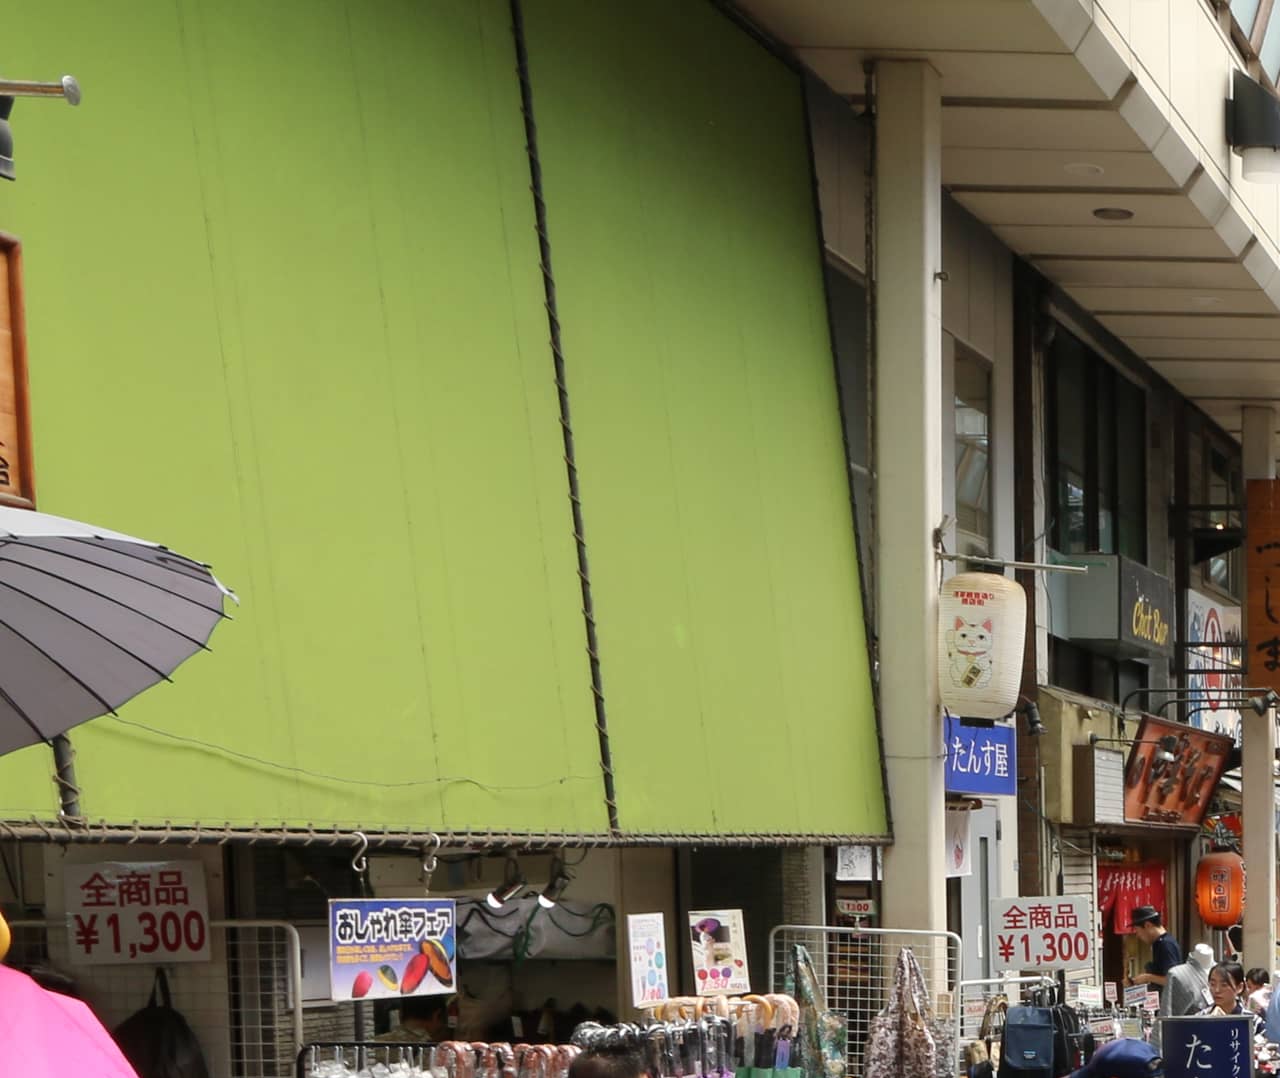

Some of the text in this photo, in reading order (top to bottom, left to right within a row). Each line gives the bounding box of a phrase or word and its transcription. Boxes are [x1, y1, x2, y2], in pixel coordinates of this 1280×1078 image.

[944, 736, 1009, 777] たんす屋
[80, 869, 190, 907] 全商品
[75, 910, 206, 958] ¥1,300
[336, 908, 451, 943] おしゃれ傘フェア
[1003, 904, 1077, 929] 全商品
[997, 932, 1089, 965] ¥1,300
